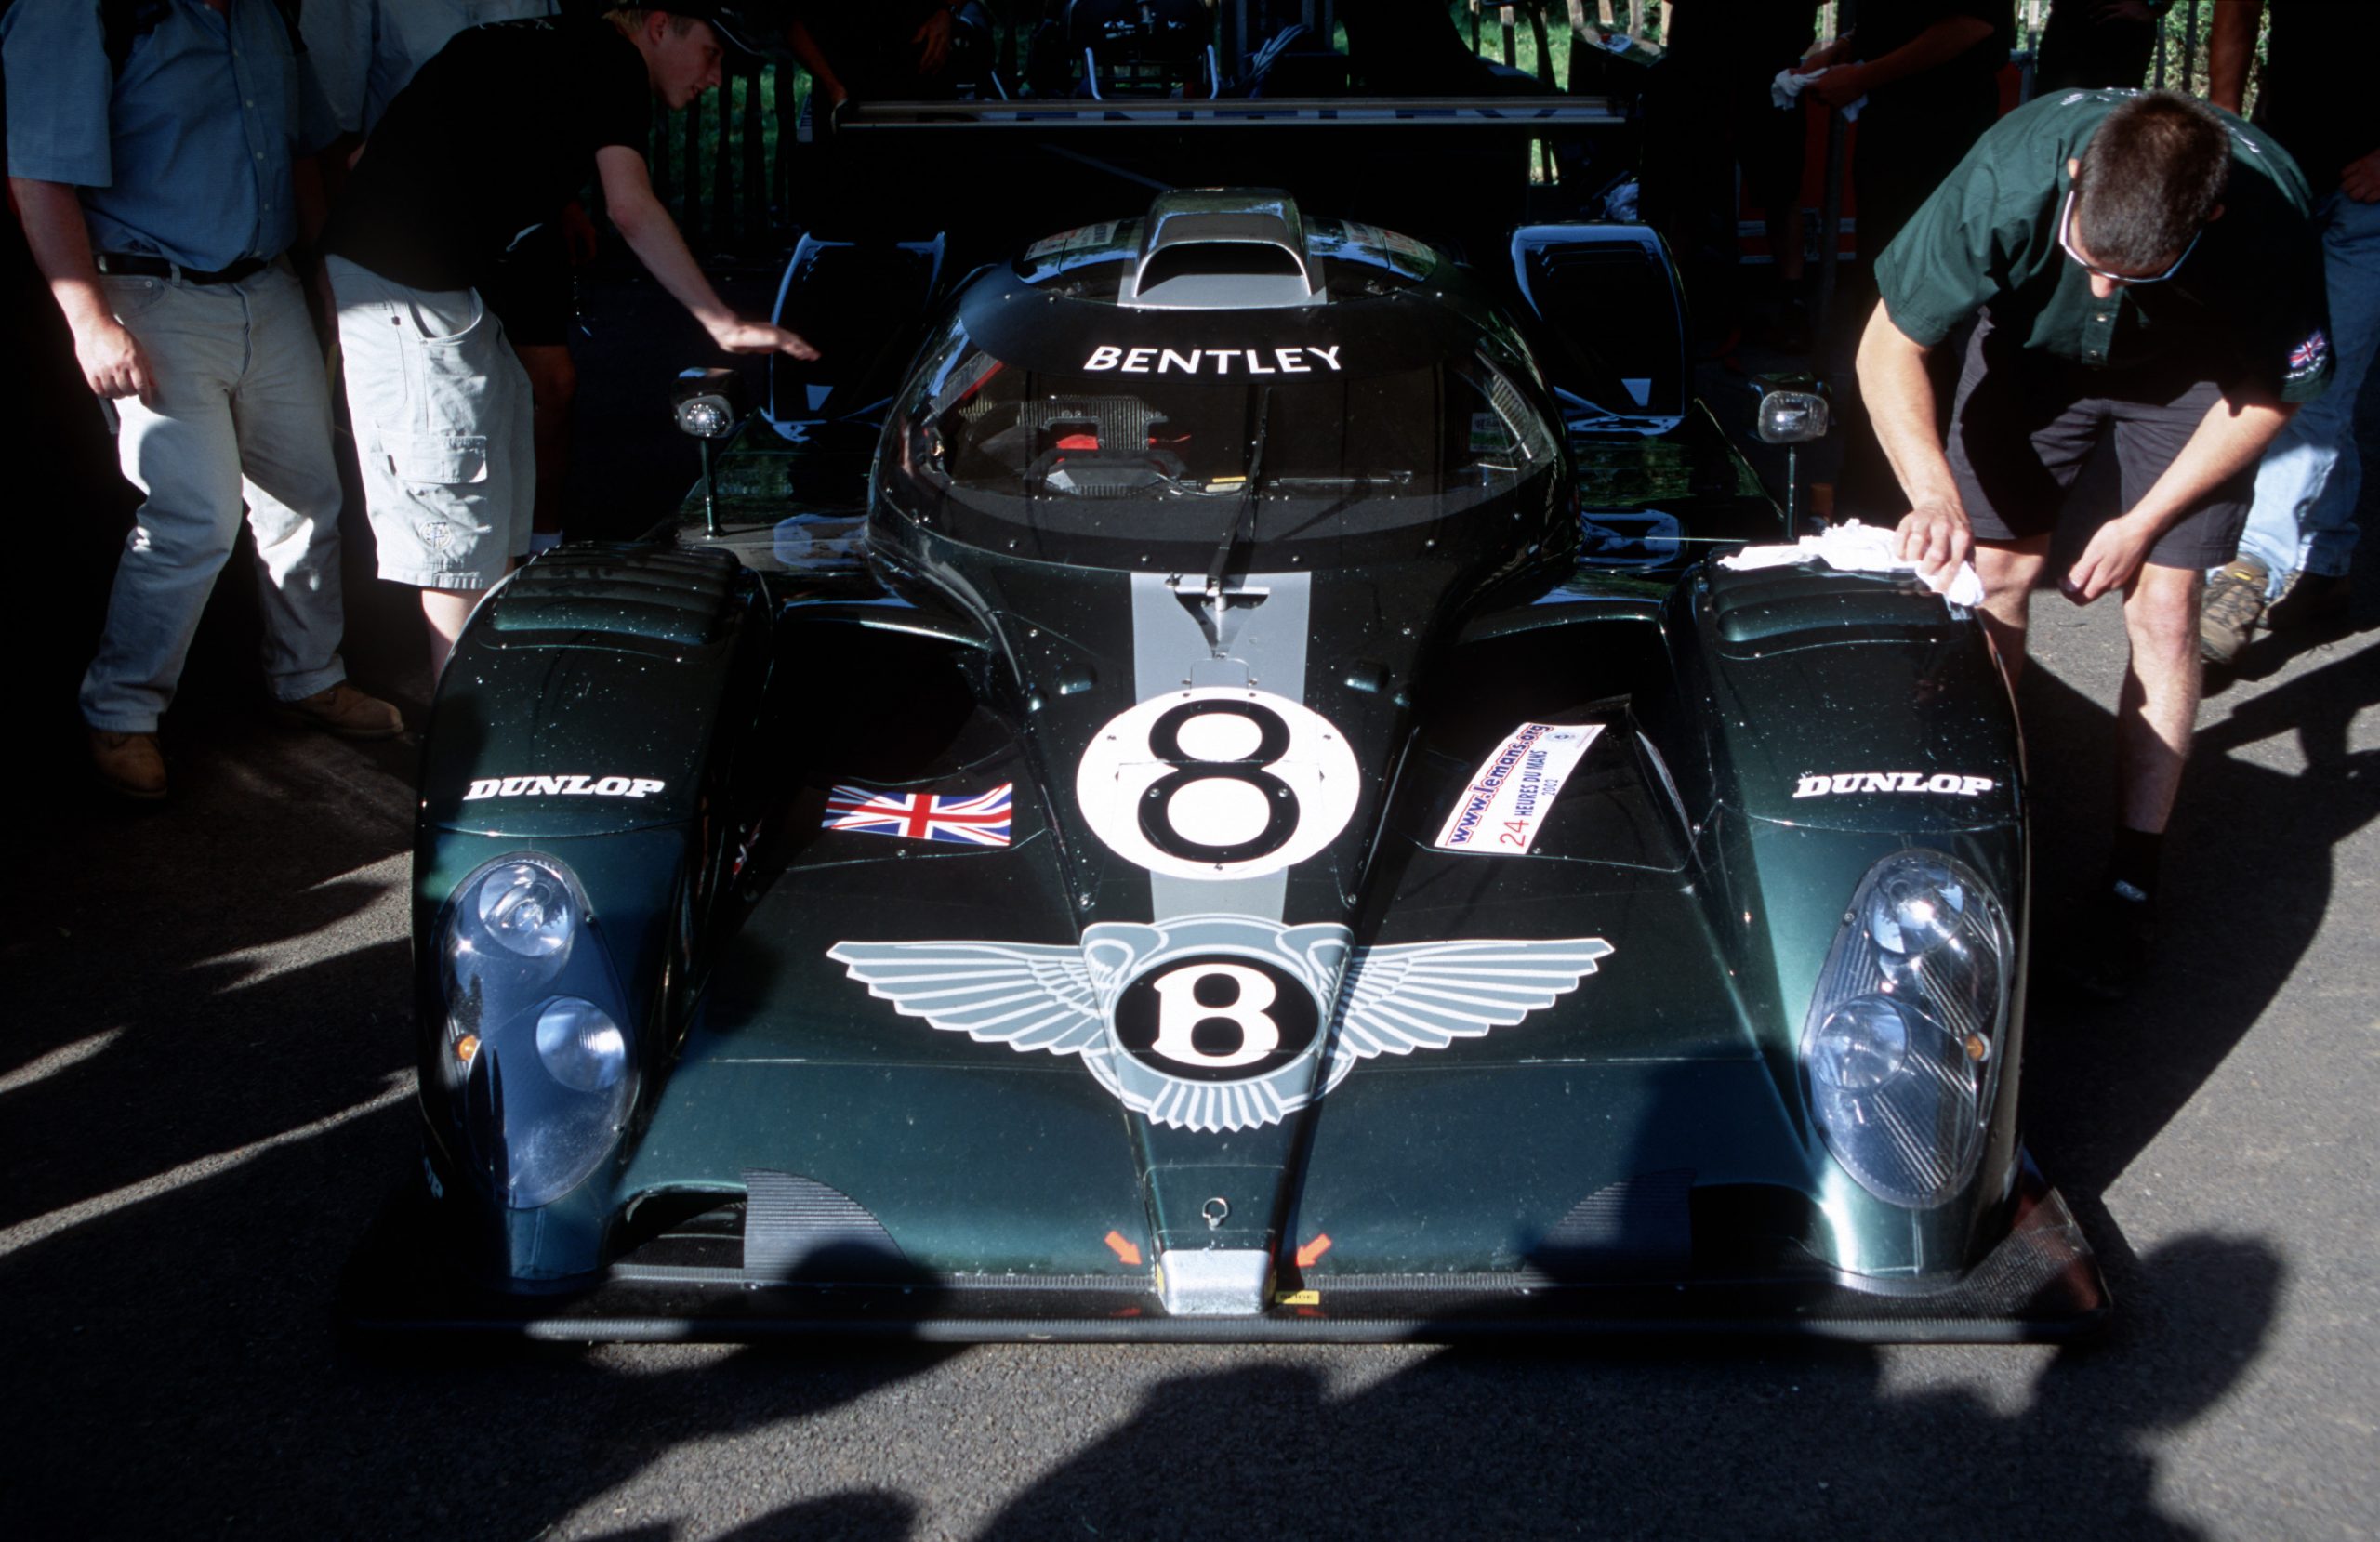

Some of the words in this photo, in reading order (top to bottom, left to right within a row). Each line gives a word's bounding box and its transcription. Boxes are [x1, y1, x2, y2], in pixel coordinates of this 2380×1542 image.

[1083, 345, 1342, 374] BENTLEY
[1525, 750, 1548, 771] MANS
[463, 775, 666, 801] DUNLOP
[1138, 698, 1301, 863] 8
[1448, 724, 1552, 844] www.lemans.org
[1523, 771, 1542, 783] DU
[1541, 779, 1558, 796] 2002
[1792, 772, 1993, 798] DUNLOP
[1514, 784, 1539, 816] HEURES
[1500, 820, 1529, 848] 24
[1152, 963, 1279, 1067] B
